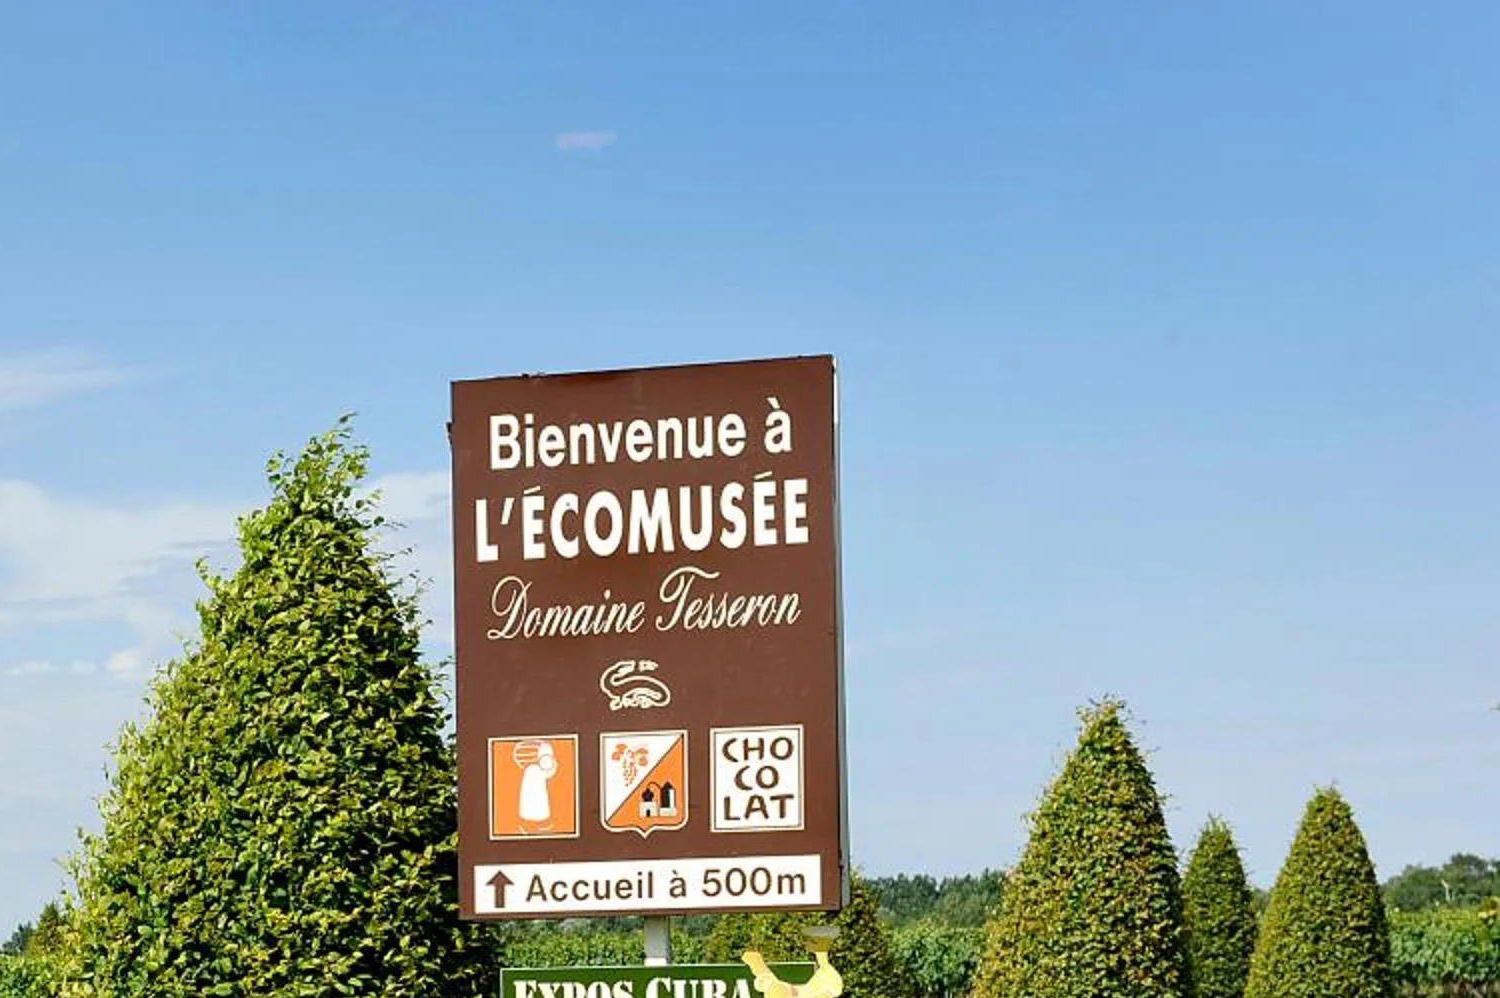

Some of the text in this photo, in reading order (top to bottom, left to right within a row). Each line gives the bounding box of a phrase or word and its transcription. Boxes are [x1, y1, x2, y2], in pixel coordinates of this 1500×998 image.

[489, 397, 792, 470] Bienvenue à
[475, 471, 810, 562] L'ÉCOMUSÉE
[487, 566, 801, 640] Domaine Tesseron
[723, 737, 794, 762] CHO
[734, 766, 779, 790] CO
[723, 794, 795, 820] LAT
[526, 867, 806, 902] Accueil à 500m
